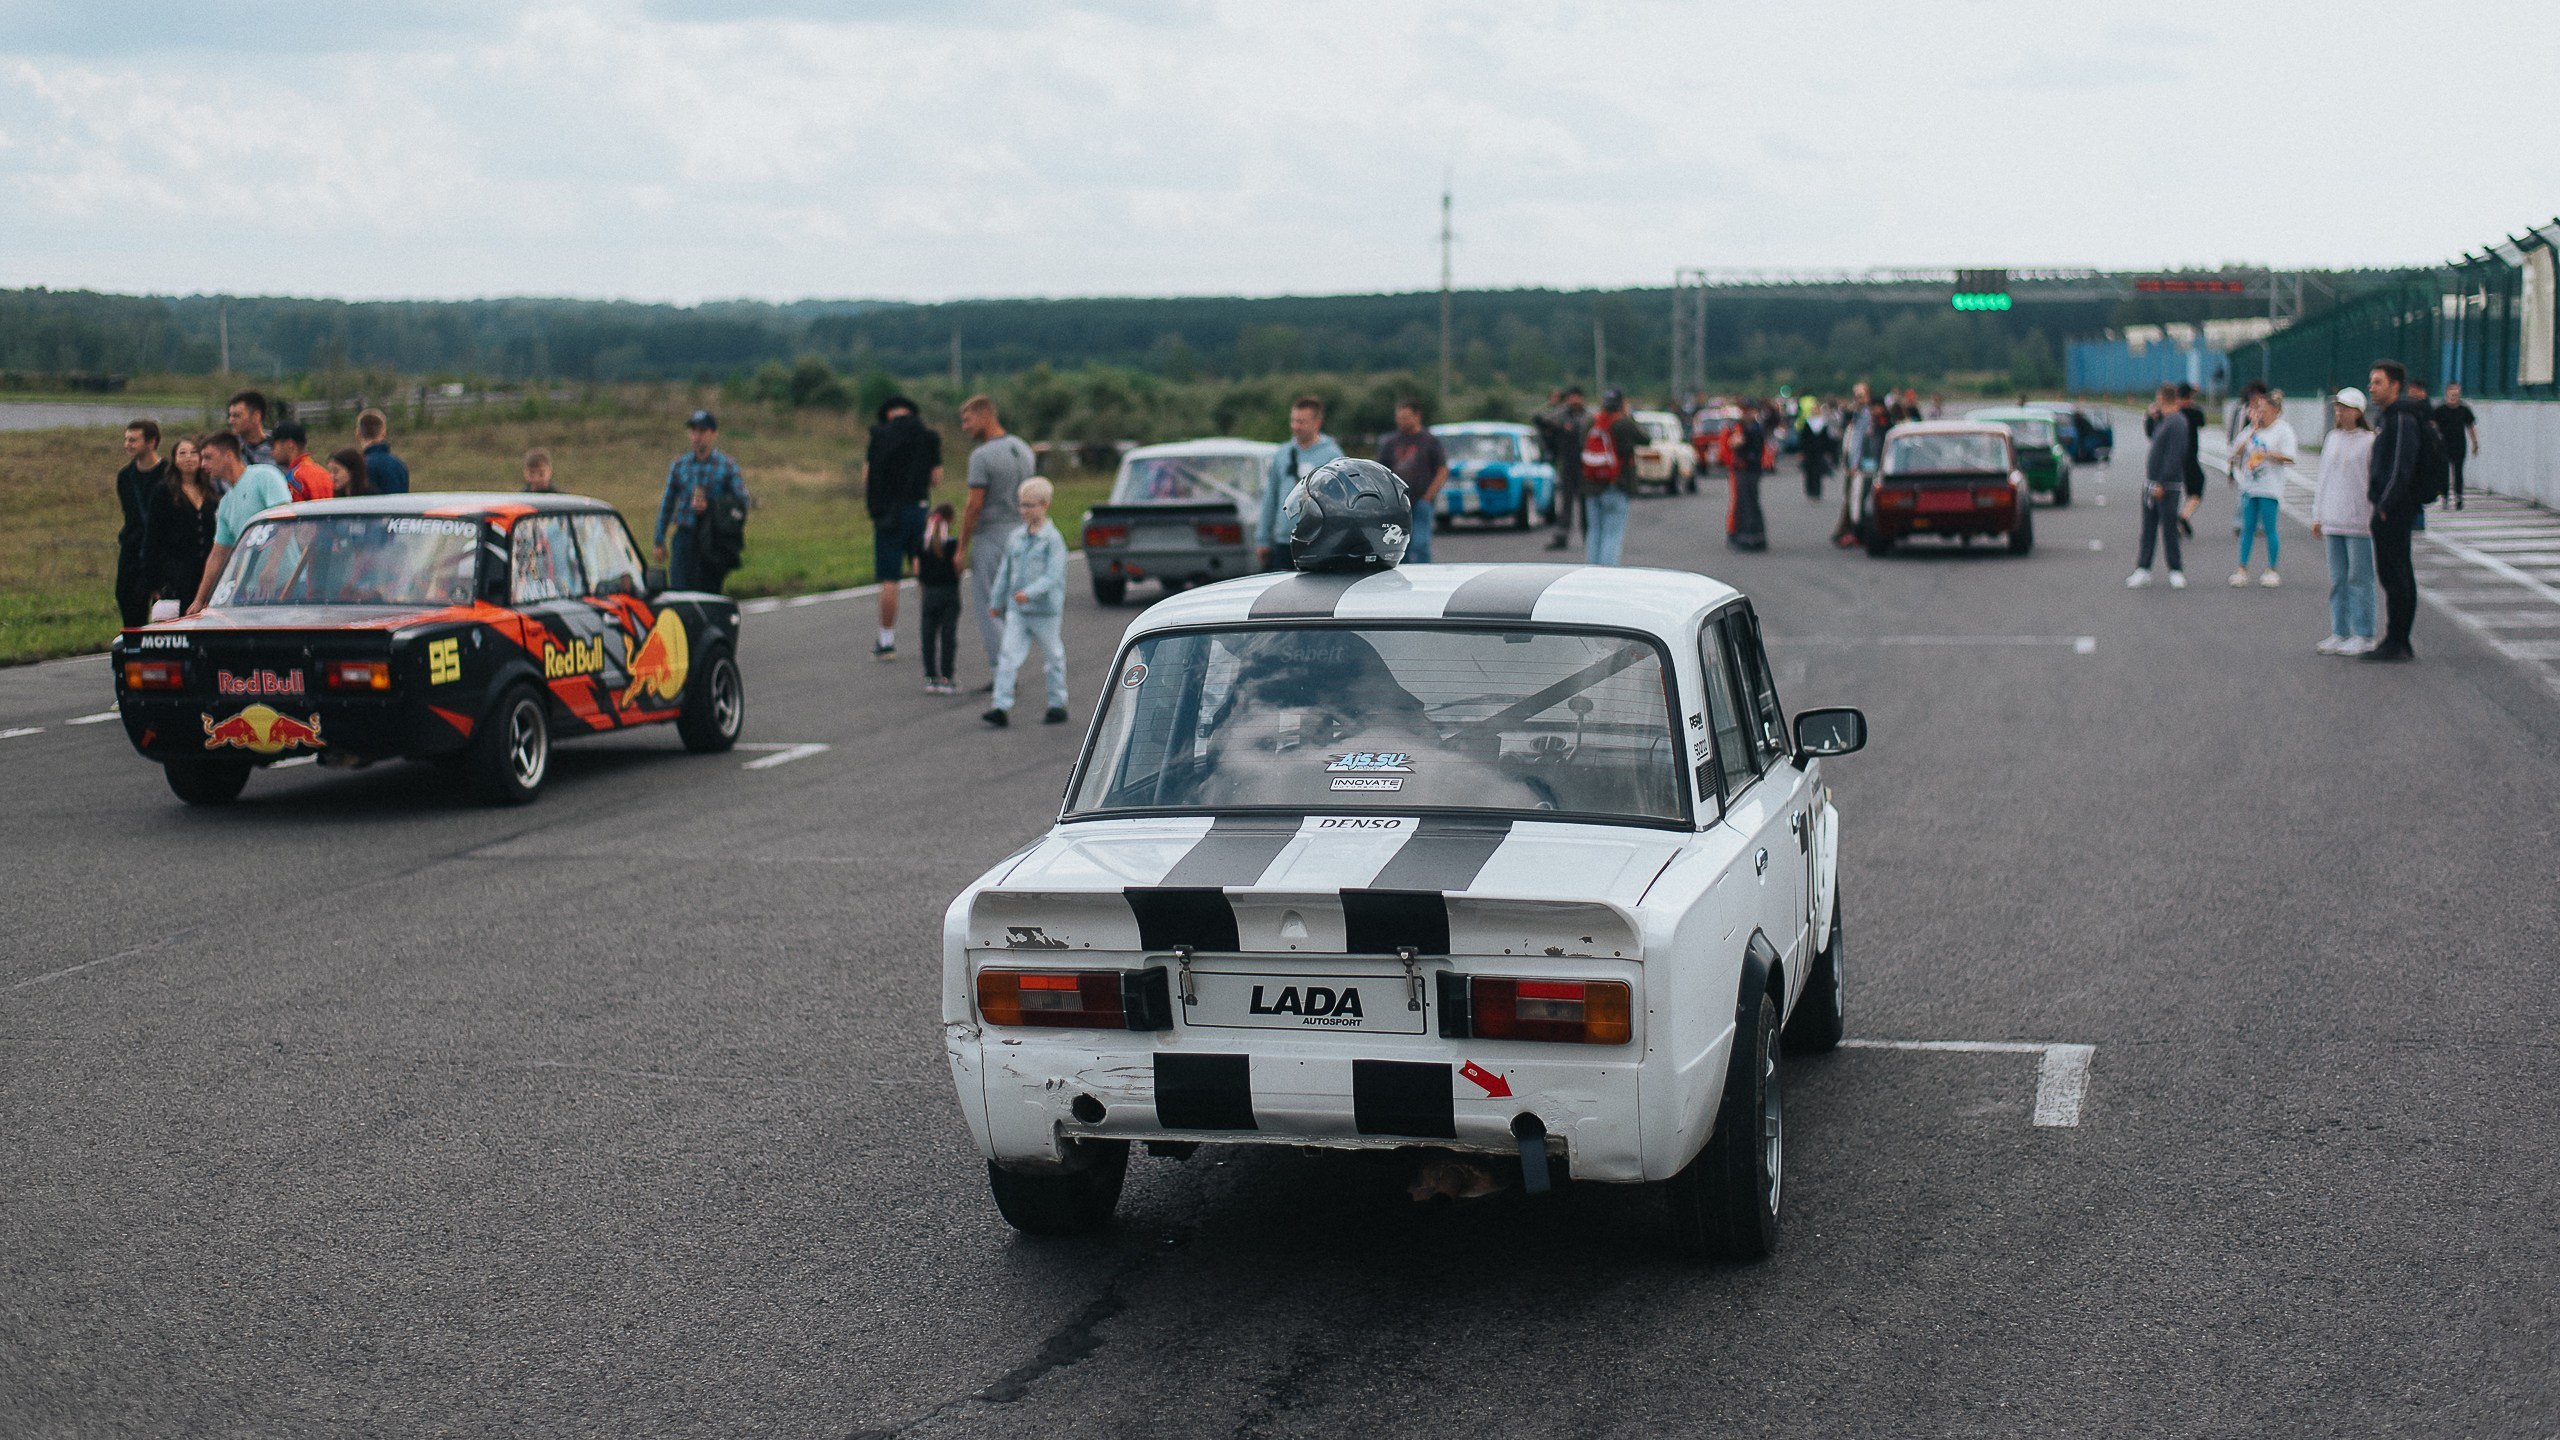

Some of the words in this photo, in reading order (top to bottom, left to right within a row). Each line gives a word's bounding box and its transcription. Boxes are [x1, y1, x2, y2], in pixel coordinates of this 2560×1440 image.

[387, 518, 477, 538] KEMEROVO
[141, 635, 190, 649] MOTUL
[428, 637, 461, 685] 95
[543, 640, 575, 679] Red
[576, 633, 604, 674] Bull
[217, 669, 261, 695] Red
[261, 668, 305, 695] Bull
[1319, 819, 1402, 829] DENSO
[1249, 985, 1364, 1018] LADA
[1302, 1017, 1362, 1027] AUTOSPORT
